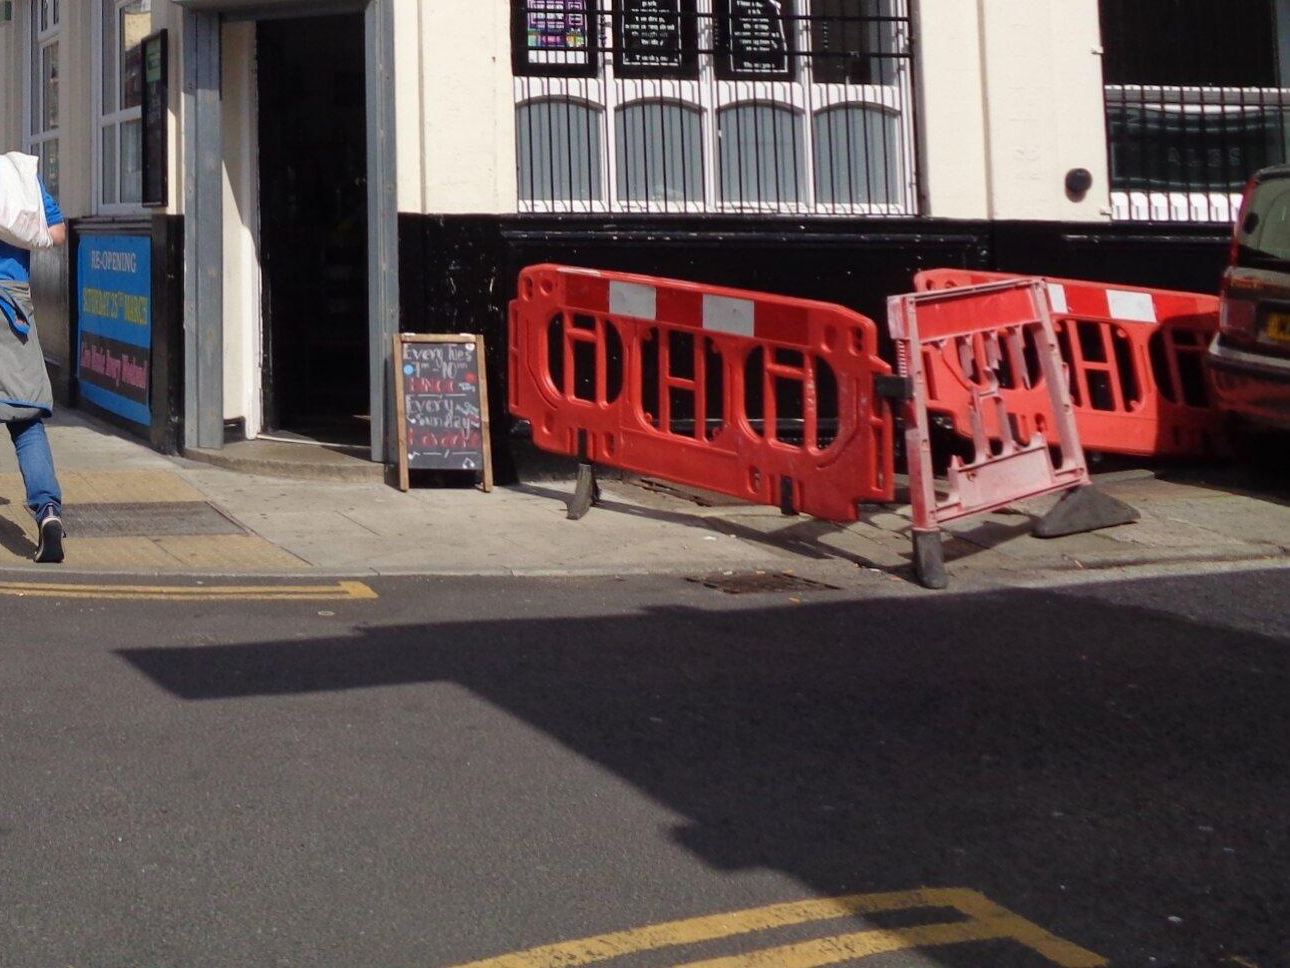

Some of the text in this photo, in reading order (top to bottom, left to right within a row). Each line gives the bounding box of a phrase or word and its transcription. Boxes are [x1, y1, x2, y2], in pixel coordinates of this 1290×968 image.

[91, 250, 137, 273] RE-OPENING
[403, 343, 472, 368] Every Tues
[405, 394, 454, 416] Every
[415, 412, 471, 440] Sunday
